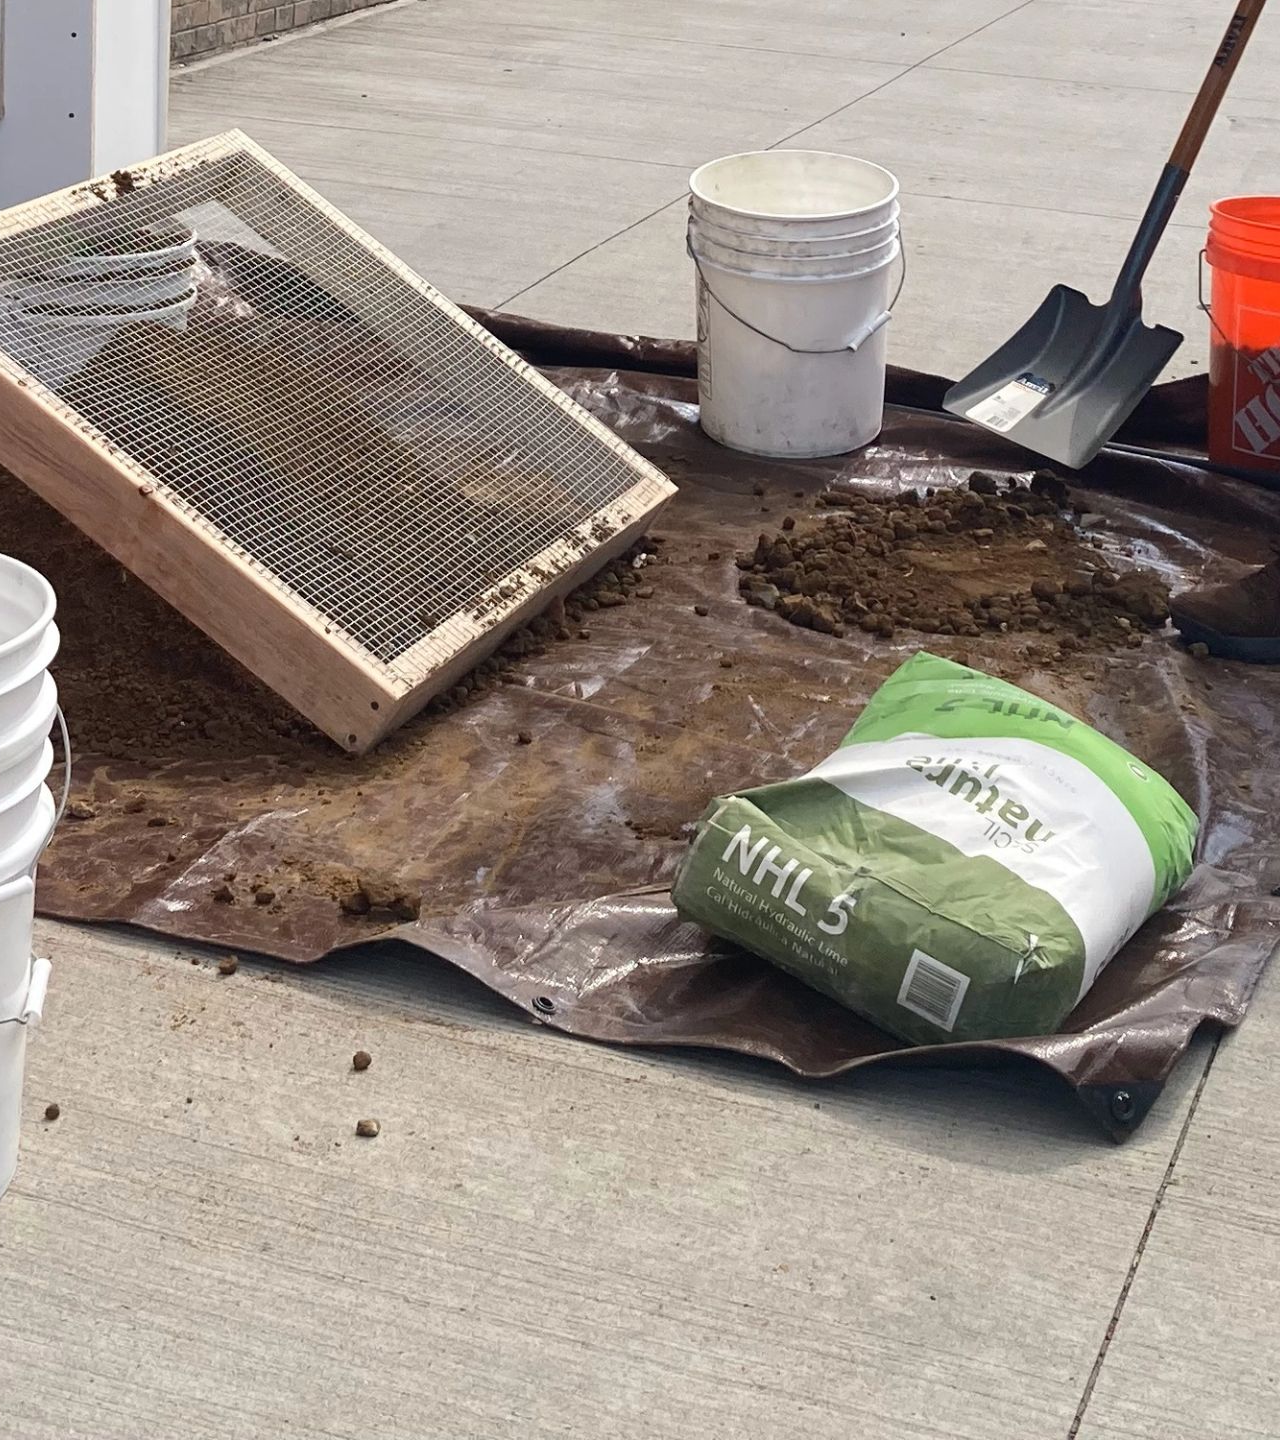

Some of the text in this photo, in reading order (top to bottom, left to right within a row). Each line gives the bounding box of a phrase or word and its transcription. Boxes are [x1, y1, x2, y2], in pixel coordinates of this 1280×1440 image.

[706, 885, 726, 905] Cal
[712, 866, 849, 969] Natural Hydraulic Lime
[721, 823, 858, 936] NHL 5
